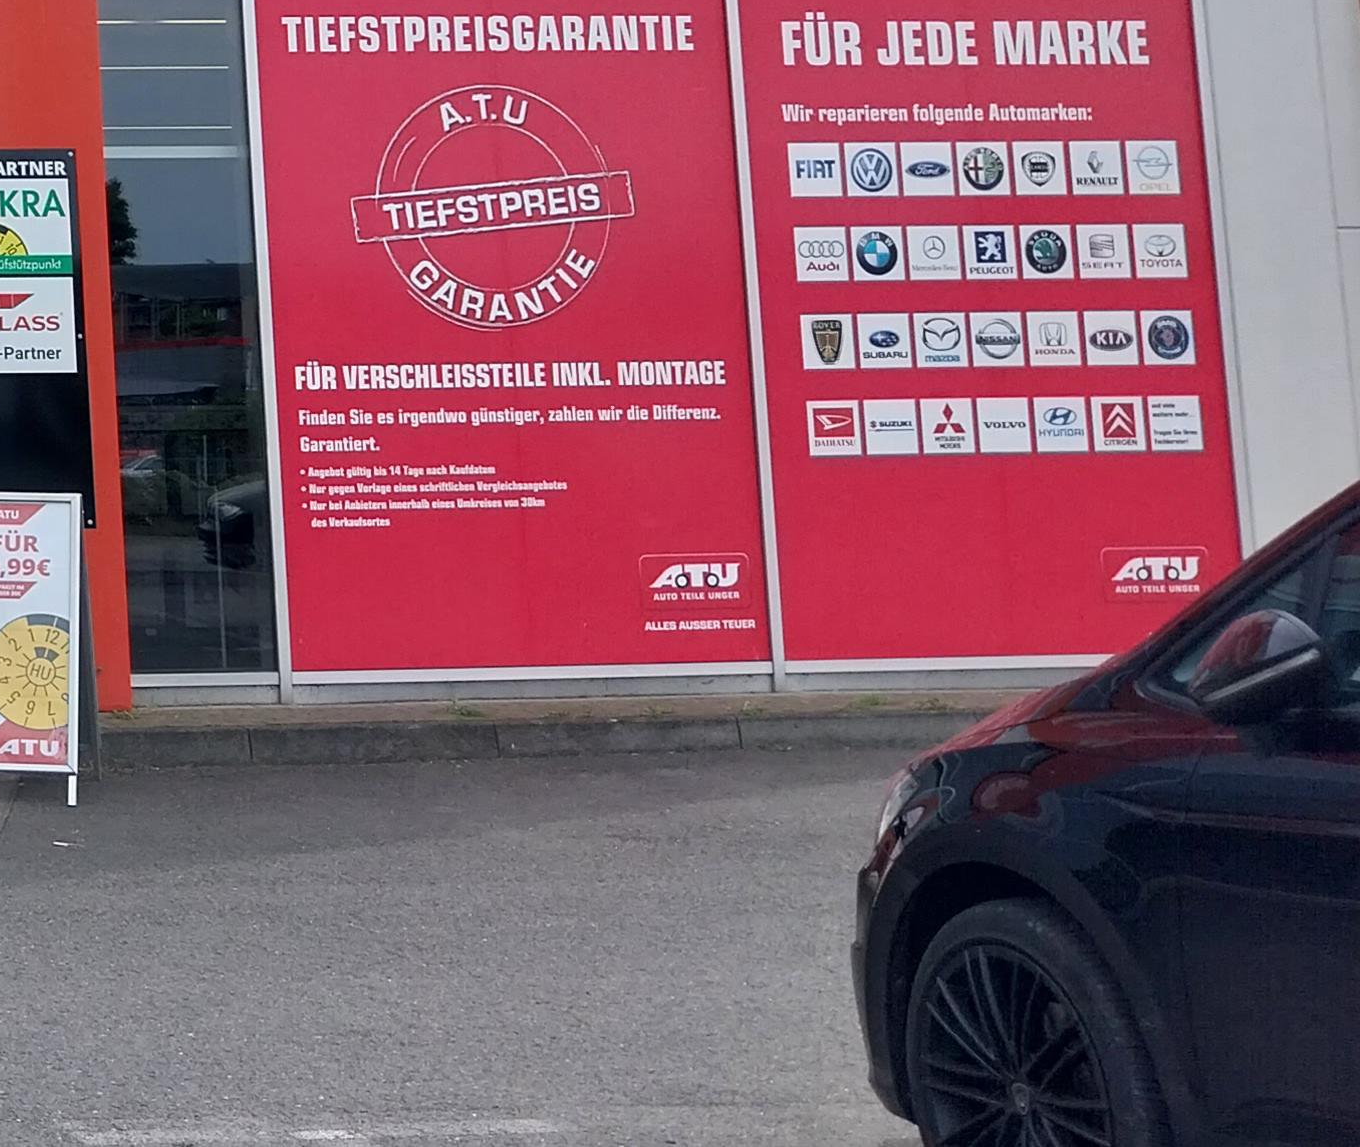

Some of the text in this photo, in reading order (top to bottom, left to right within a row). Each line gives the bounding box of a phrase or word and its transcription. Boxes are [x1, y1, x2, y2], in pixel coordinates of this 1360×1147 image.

[282, 15, 694, 52] TIEFSTPREISGARANTIE
[780, 11, 1150, 66] FÜR JEDE MARKE
[440, 94, 528, 132] A.T.U
[782, 103, 1093, 125] Wir reparieren folgende Automarken:
[796, 160, 835, 179] FIAT
[915, 164, 941, 176] Ford
[1076, 176, 1118, 186] RENAULT
[1139, 183, 1172, 192] OPEL
[383, 184, 601, 231] TIEFSTPREIS
[806, 262, 840, 271] Audi
[1140, 259, 1183, 268] TOYOTA
[969, 266, 1014, 275] PEUGEOT
[410, 248, 595, 322] GARANTIE
[979, 335, 1017, 344] NISSAN
[1096, 332, 1127, 345] KIA
[862, 351, 908, 359] SUBARU
[294, 360, 726, 390] FÜR VERSCHLEISSTEILE INKL. MONTAGE
[298, 405, 721, 427] Finden Sie es irgendwo günstiger, zahlen wir die Differenz.
[879, 420, 912, 428] SUZUKI
[984, 421, 1026, 429] VOLVO
[1039, 429, 1084, 437] HYUNDAI
[300, 436, 380, 452] Garantiert.
[814, 440, 855, 448] DAIHATSU
[308, 465, 496, 479] Angebot gültig bis 14 Tage nach Kaufdatum
[309, 484, 327, 494] Nur
[329, 485, 355, 496] gegen
[357, 483, 392, 495] Vorlage
[394, 482, 418, 492] eines
[310, 501, 327, 511] Nur
[329, 500, 343, 510] bei
[432, 499, 455, 509] eines
[504, 499, 520, 508] von
[311, 517, 390, 528] des Verkaufsortes
[1111, 557, 1200, 581] ATU
[649, 563, 740, 588] ATU
[1115, 584, 1200, 593] AUTO TEILE UNGER
[653, 591, 740, 601] AUTO TEILE UNGER
[645, 619, 756, 631] ALLES AUSSER TEUER
[30, 663, 52, 681] HU
